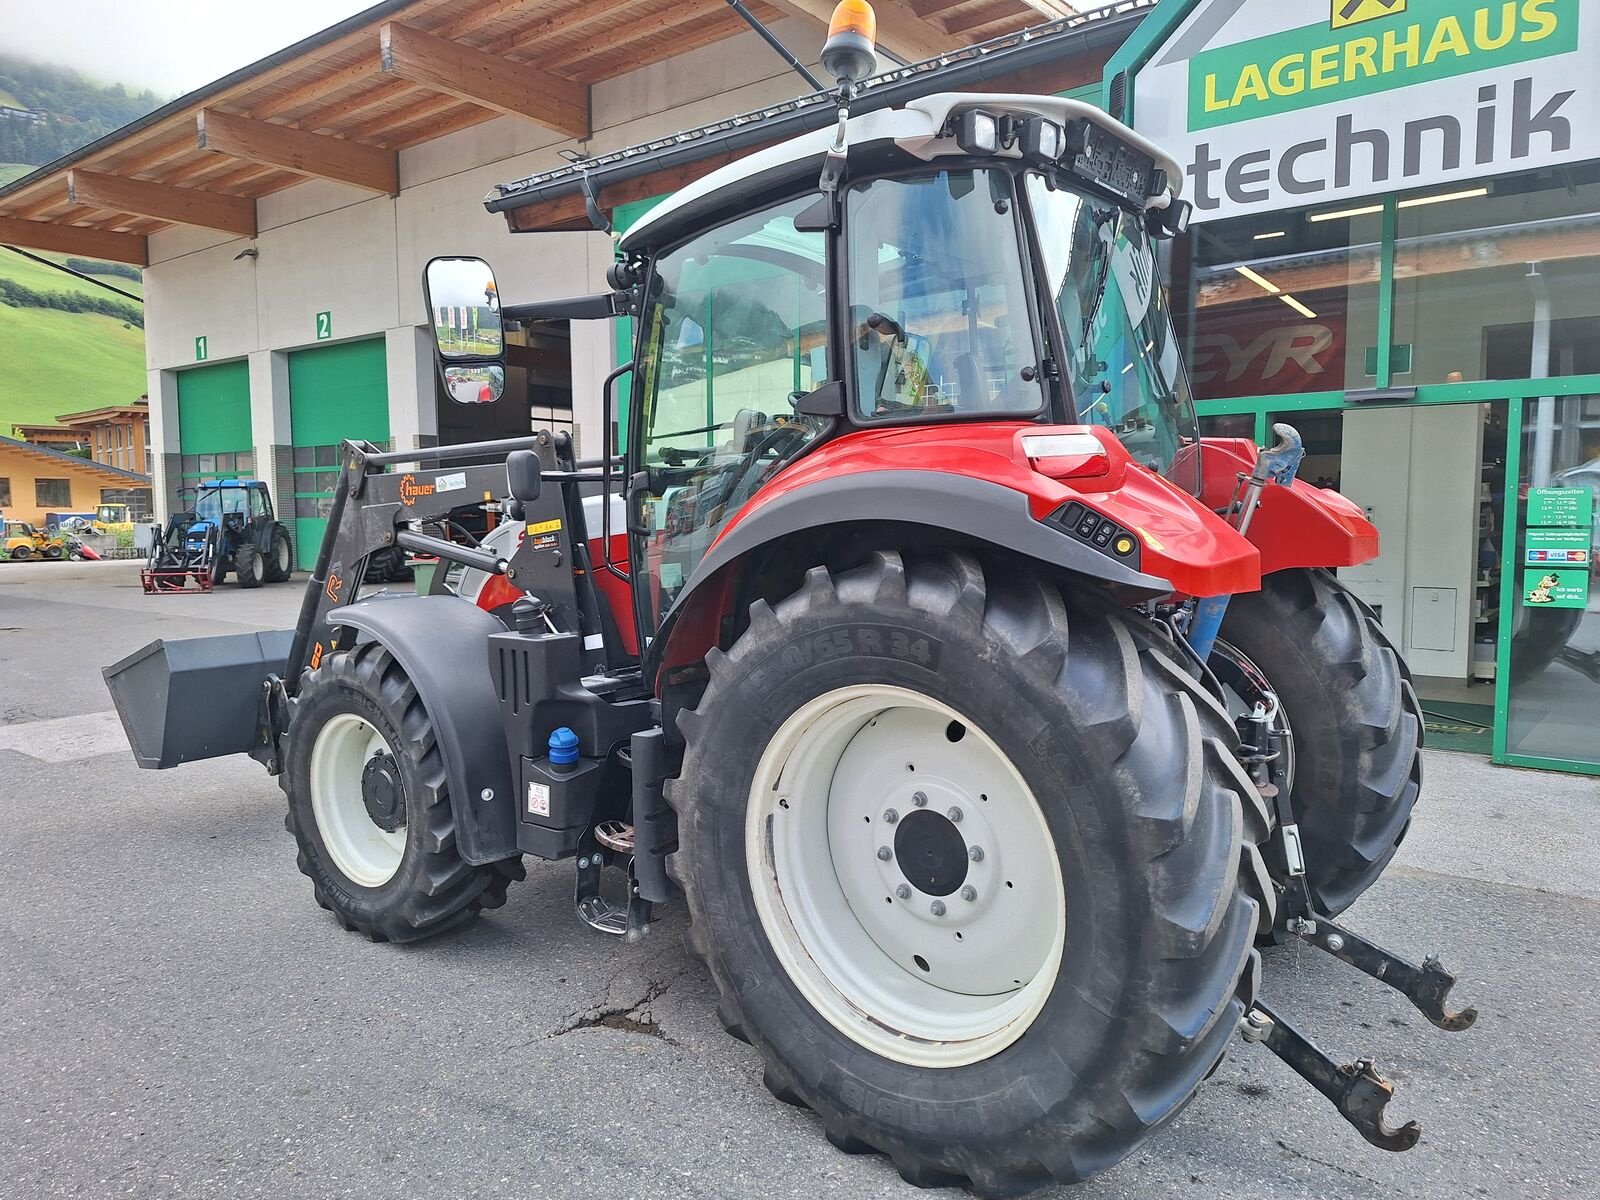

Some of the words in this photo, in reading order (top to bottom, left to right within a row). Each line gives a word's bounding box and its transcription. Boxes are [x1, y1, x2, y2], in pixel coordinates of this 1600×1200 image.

[1204, 0, 1558, 113] LAGERHAUS
[1186, 77, 1577, 211] technik
[319, 313, 329, 338] 2
[198, 337, 206, 359] 1
[405, 481, 436, 496] hauer
[889, 630, 932, 666] 34
